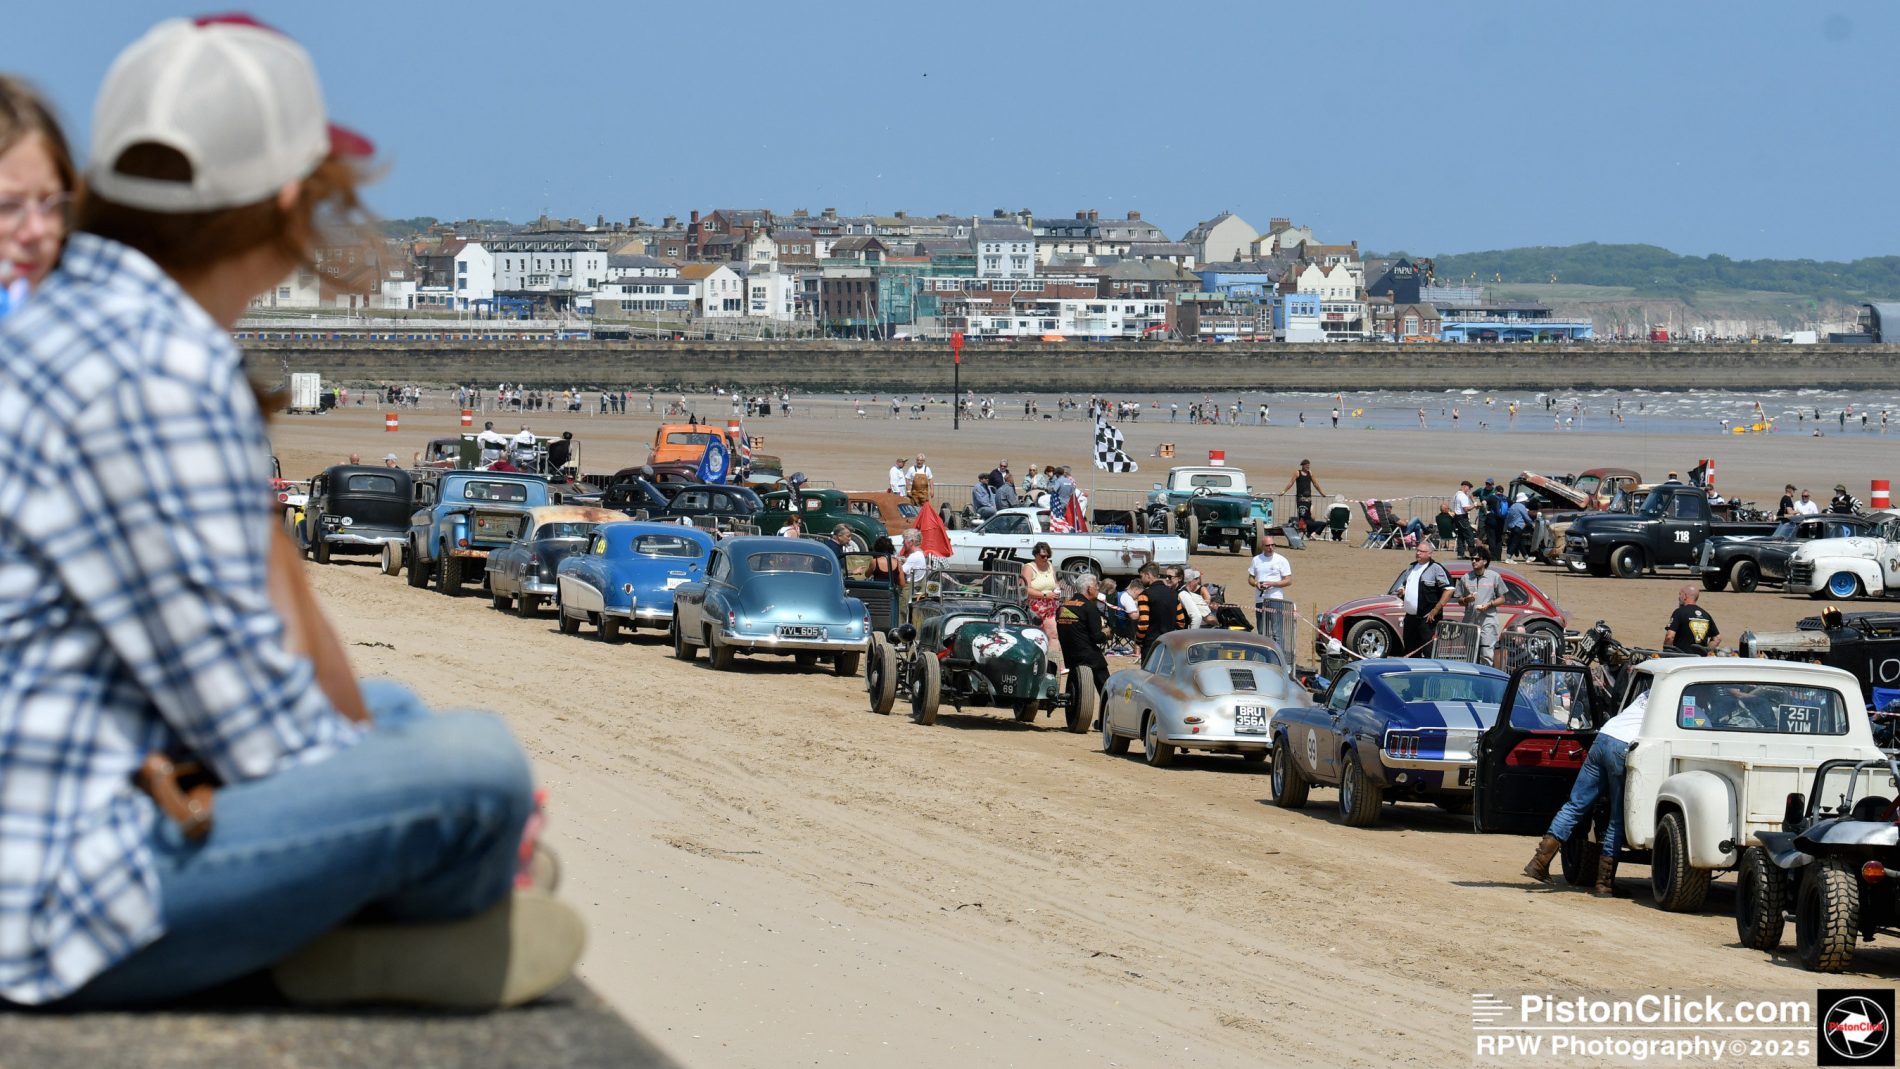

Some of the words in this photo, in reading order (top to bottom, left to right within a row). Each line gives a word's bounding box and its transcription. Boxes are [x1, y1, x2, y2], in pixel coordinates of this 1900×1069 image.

[1674, 530, 1690, 541] 118
[782, 626, 799, 636] YVL
[801, 627, 818, 636] 605
[1001, 674, 1018, 684] UHP
[1003, 684, 1014, 694] 69
[1239, 706, 1262, 717] BRU
[1788, 707, 1810, 721] 251
[1236, 715, 1266, 727] 356A
